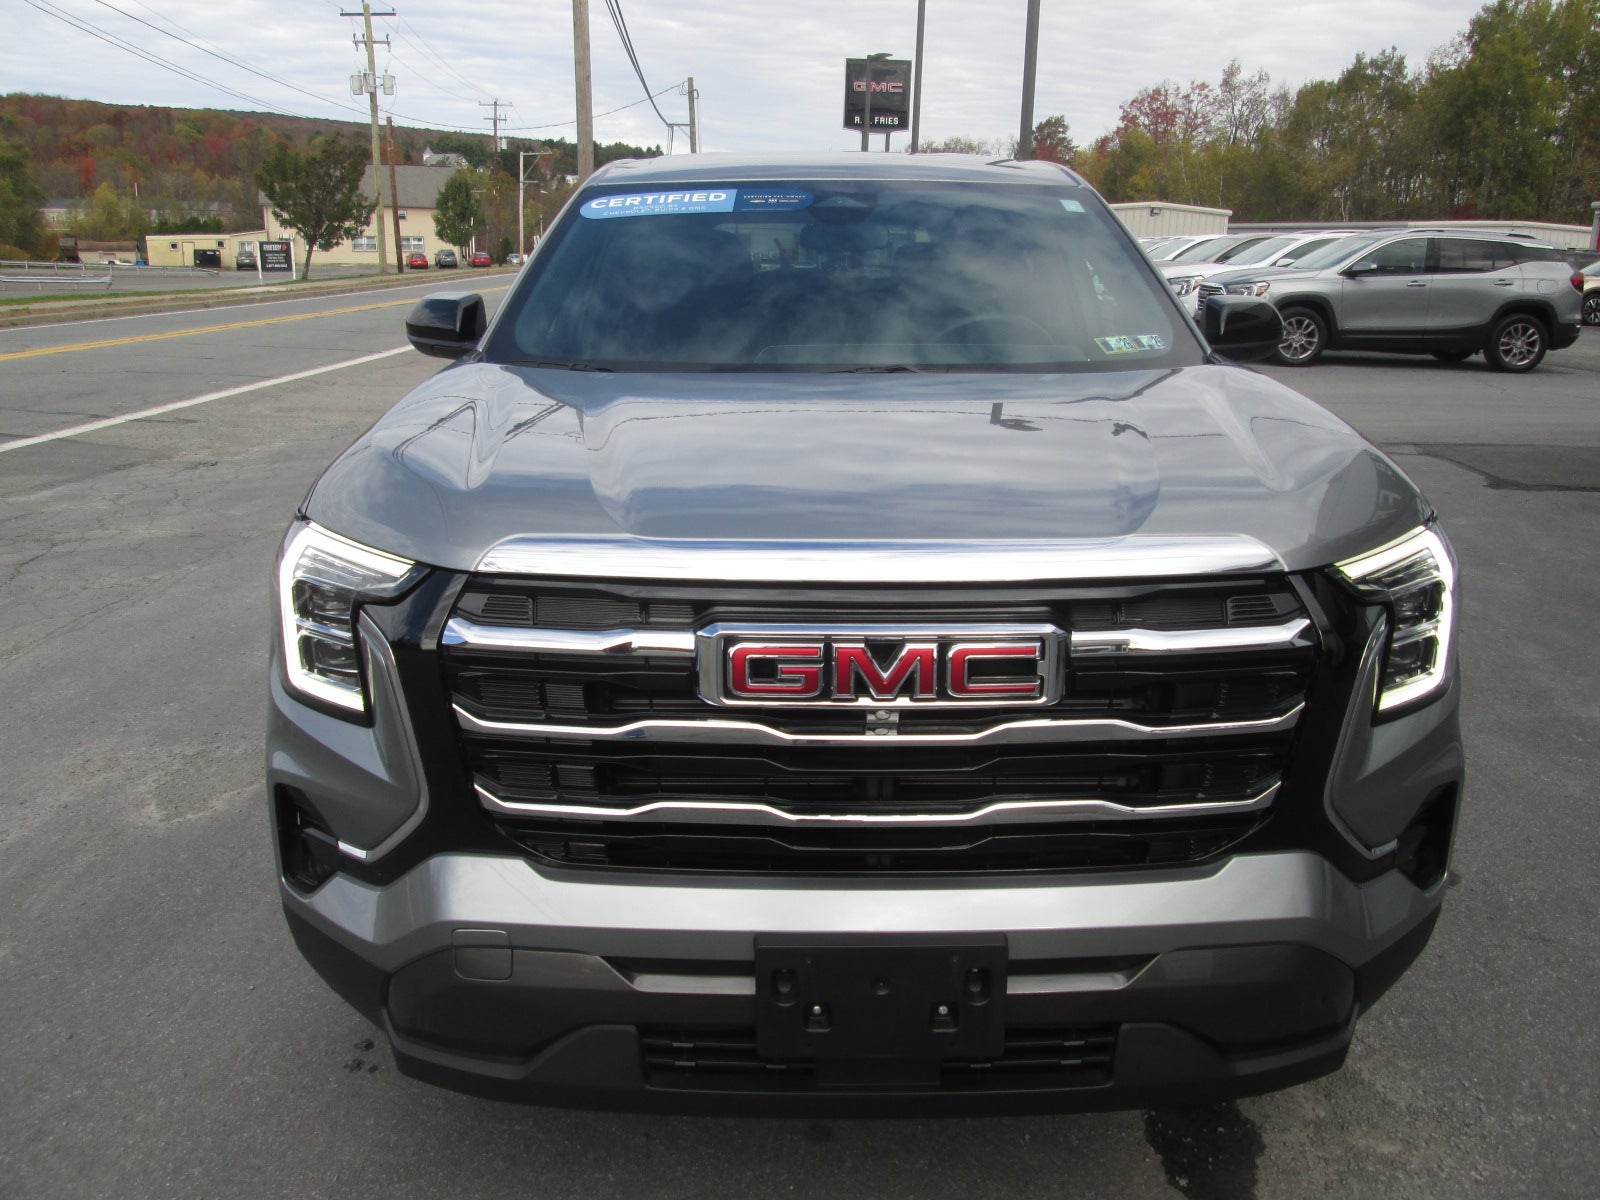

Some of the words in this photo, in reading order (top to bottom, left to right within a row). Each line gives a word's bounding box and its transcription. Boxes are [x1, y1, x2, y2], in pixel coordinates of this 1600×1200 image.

[853, 81, 903, 92] GMC
[874, 116, 899, 125] FRIES
[590, 192, 727, 209] CERTIFIED
[728, 642, 1041, 699] GMC
